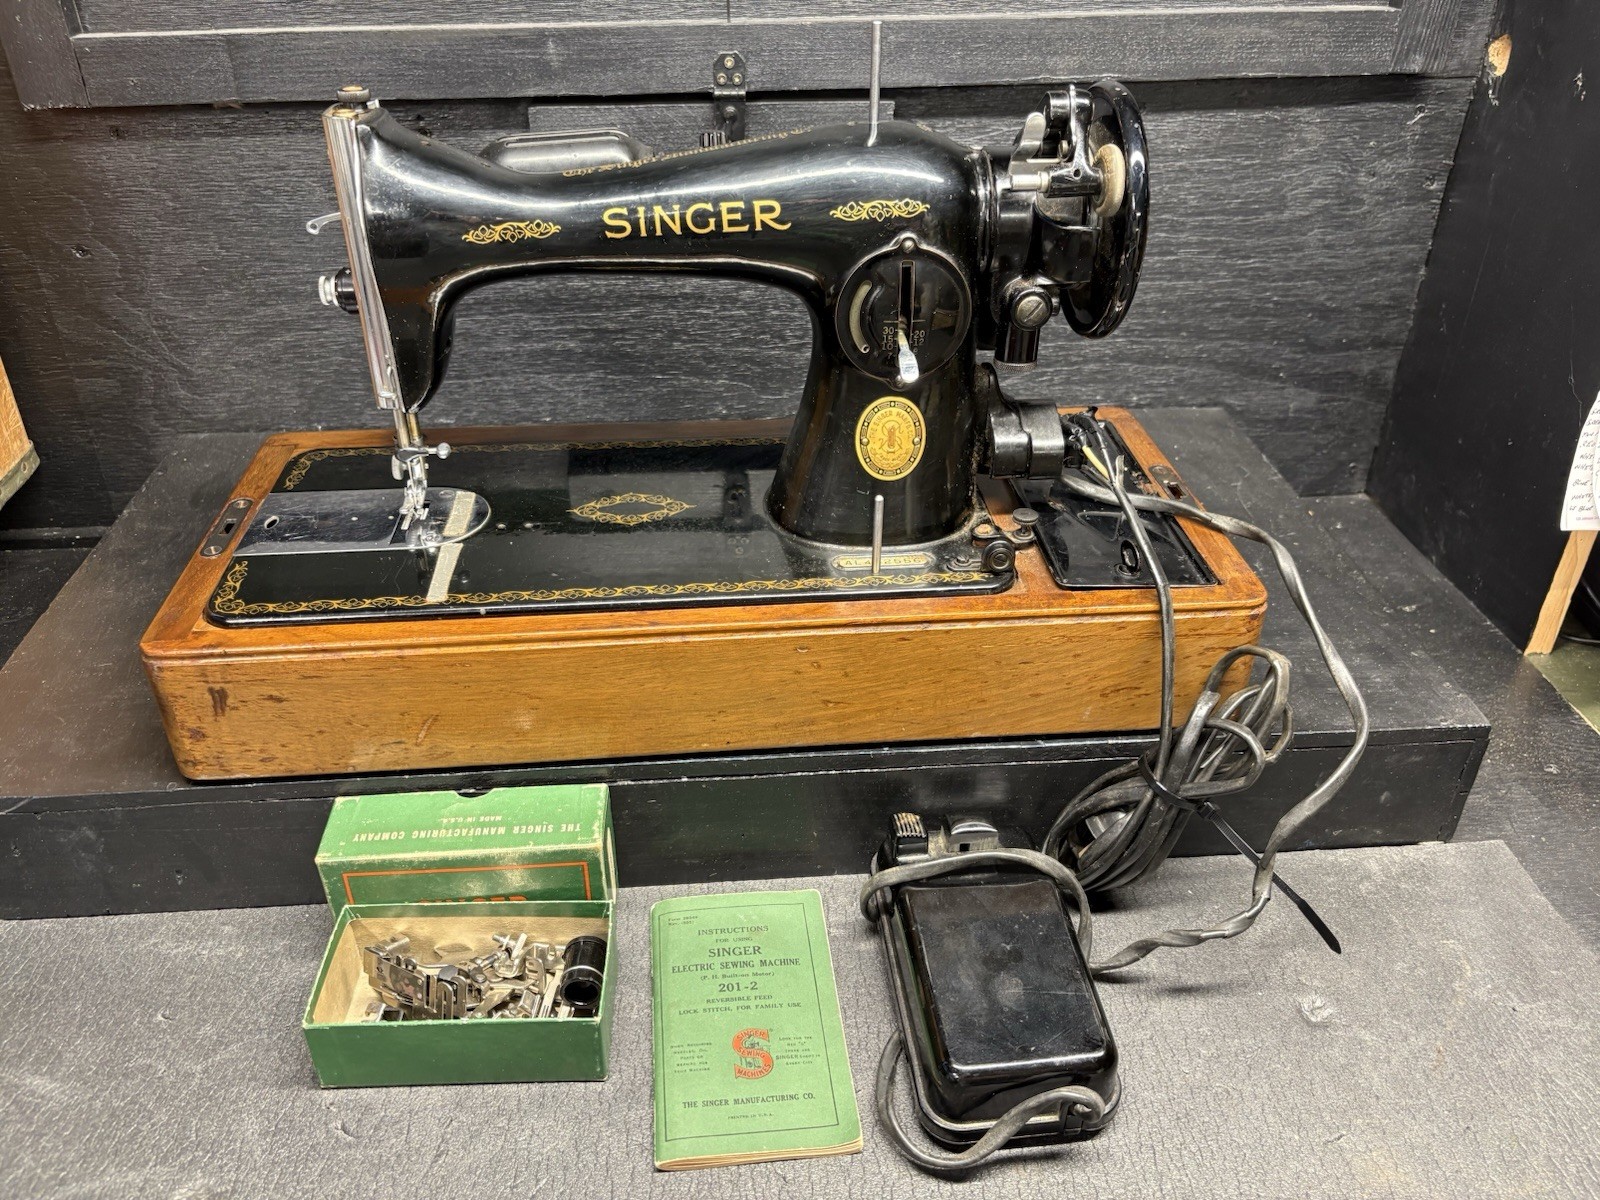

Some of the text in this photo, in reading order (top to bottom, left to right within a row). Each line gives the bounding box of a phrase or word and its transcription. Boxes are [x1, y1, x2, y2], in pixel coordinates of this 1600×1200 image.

[602, 199, 792, 239] SINGER
[882, 326, 894, 335] 30
[913, 330, 925, 338] 20
[882, 335, 893, 343] 15
[913, 338, 925, 346] 12
[881, 342, 894, 350] 10
[352, 823, 582, 842] THE SINGER MANUFACTURING COMPANY
[697, 925, 769, 936] INSTRUCTIONS
[708, 945, 763, 958] SINGER
[671, 958, 801, 974] ELECTRIC SEWING MACHINE
[718, 981, 759, 993] 201-2
[706, 995, 752, 1004] REVERSIBLE
[678, 1008, 699, 1016] LOCK
[702, 1006, 733, 1014] STITCH,
[737, 1029, 767, 1040] SINGER
[738, 1046, 766, 1059] SEWING
[737, 1063, 771, 1078] MACHINES
[682, 1101, 698, 1109] THE
[701, 1099, 729, 1107] SINGER
[733, 1093, 800, 1105] MANUFACTURING
